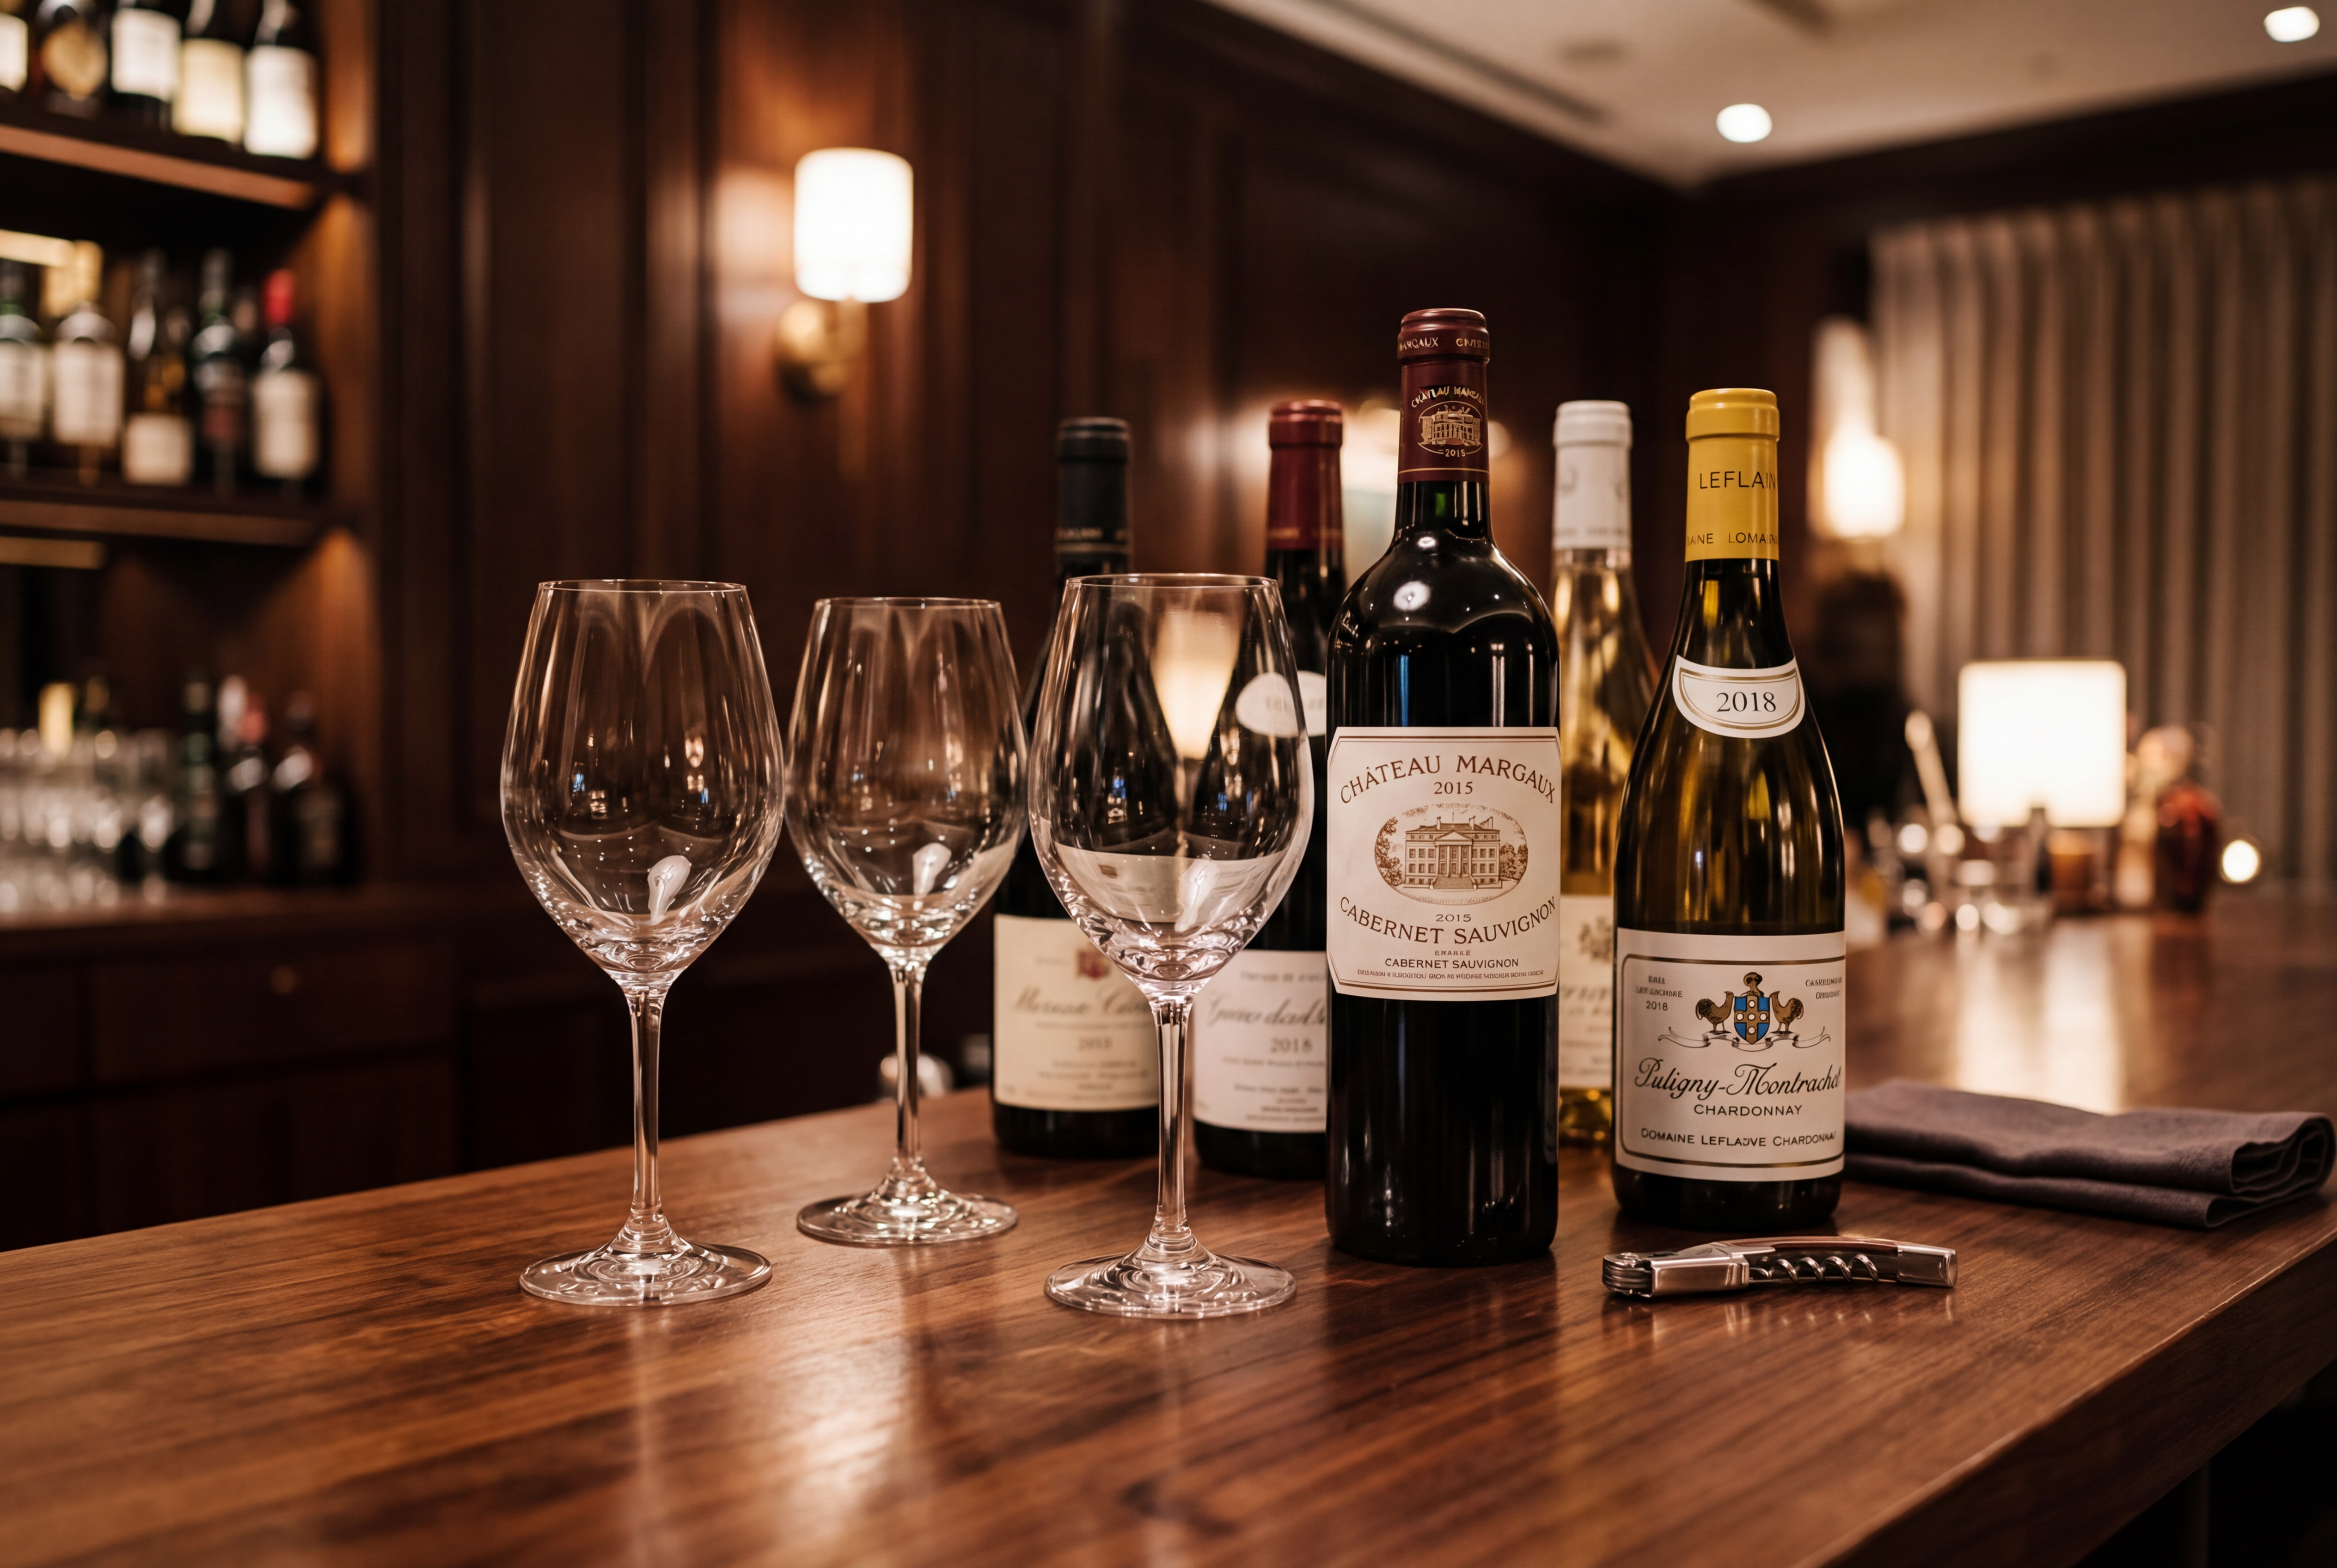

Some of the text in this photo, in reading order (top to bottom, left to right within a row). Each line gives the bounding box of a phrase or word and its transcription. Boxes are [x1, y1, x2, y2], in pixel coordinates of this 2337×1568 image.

[1716, 691, 1776, 712] 2018
[1340, 755, 1555, 804] CHÂTEAU MARGAUX
[1434, 782, 1474, 795] 2015
[1340, 896, 1556, 944] CABERNET SAUVIGNON
[1436, 914, 1472, 922] 2015
[1385, 958, 1519, 969] CABERNET SAUVIGNON
[1646, 1000, 1668, 1011] 2018
[1694, 1104, 1802, 1116] CHARDONNAY
[1641, 1128, 1695, 1144] DOMAINE
